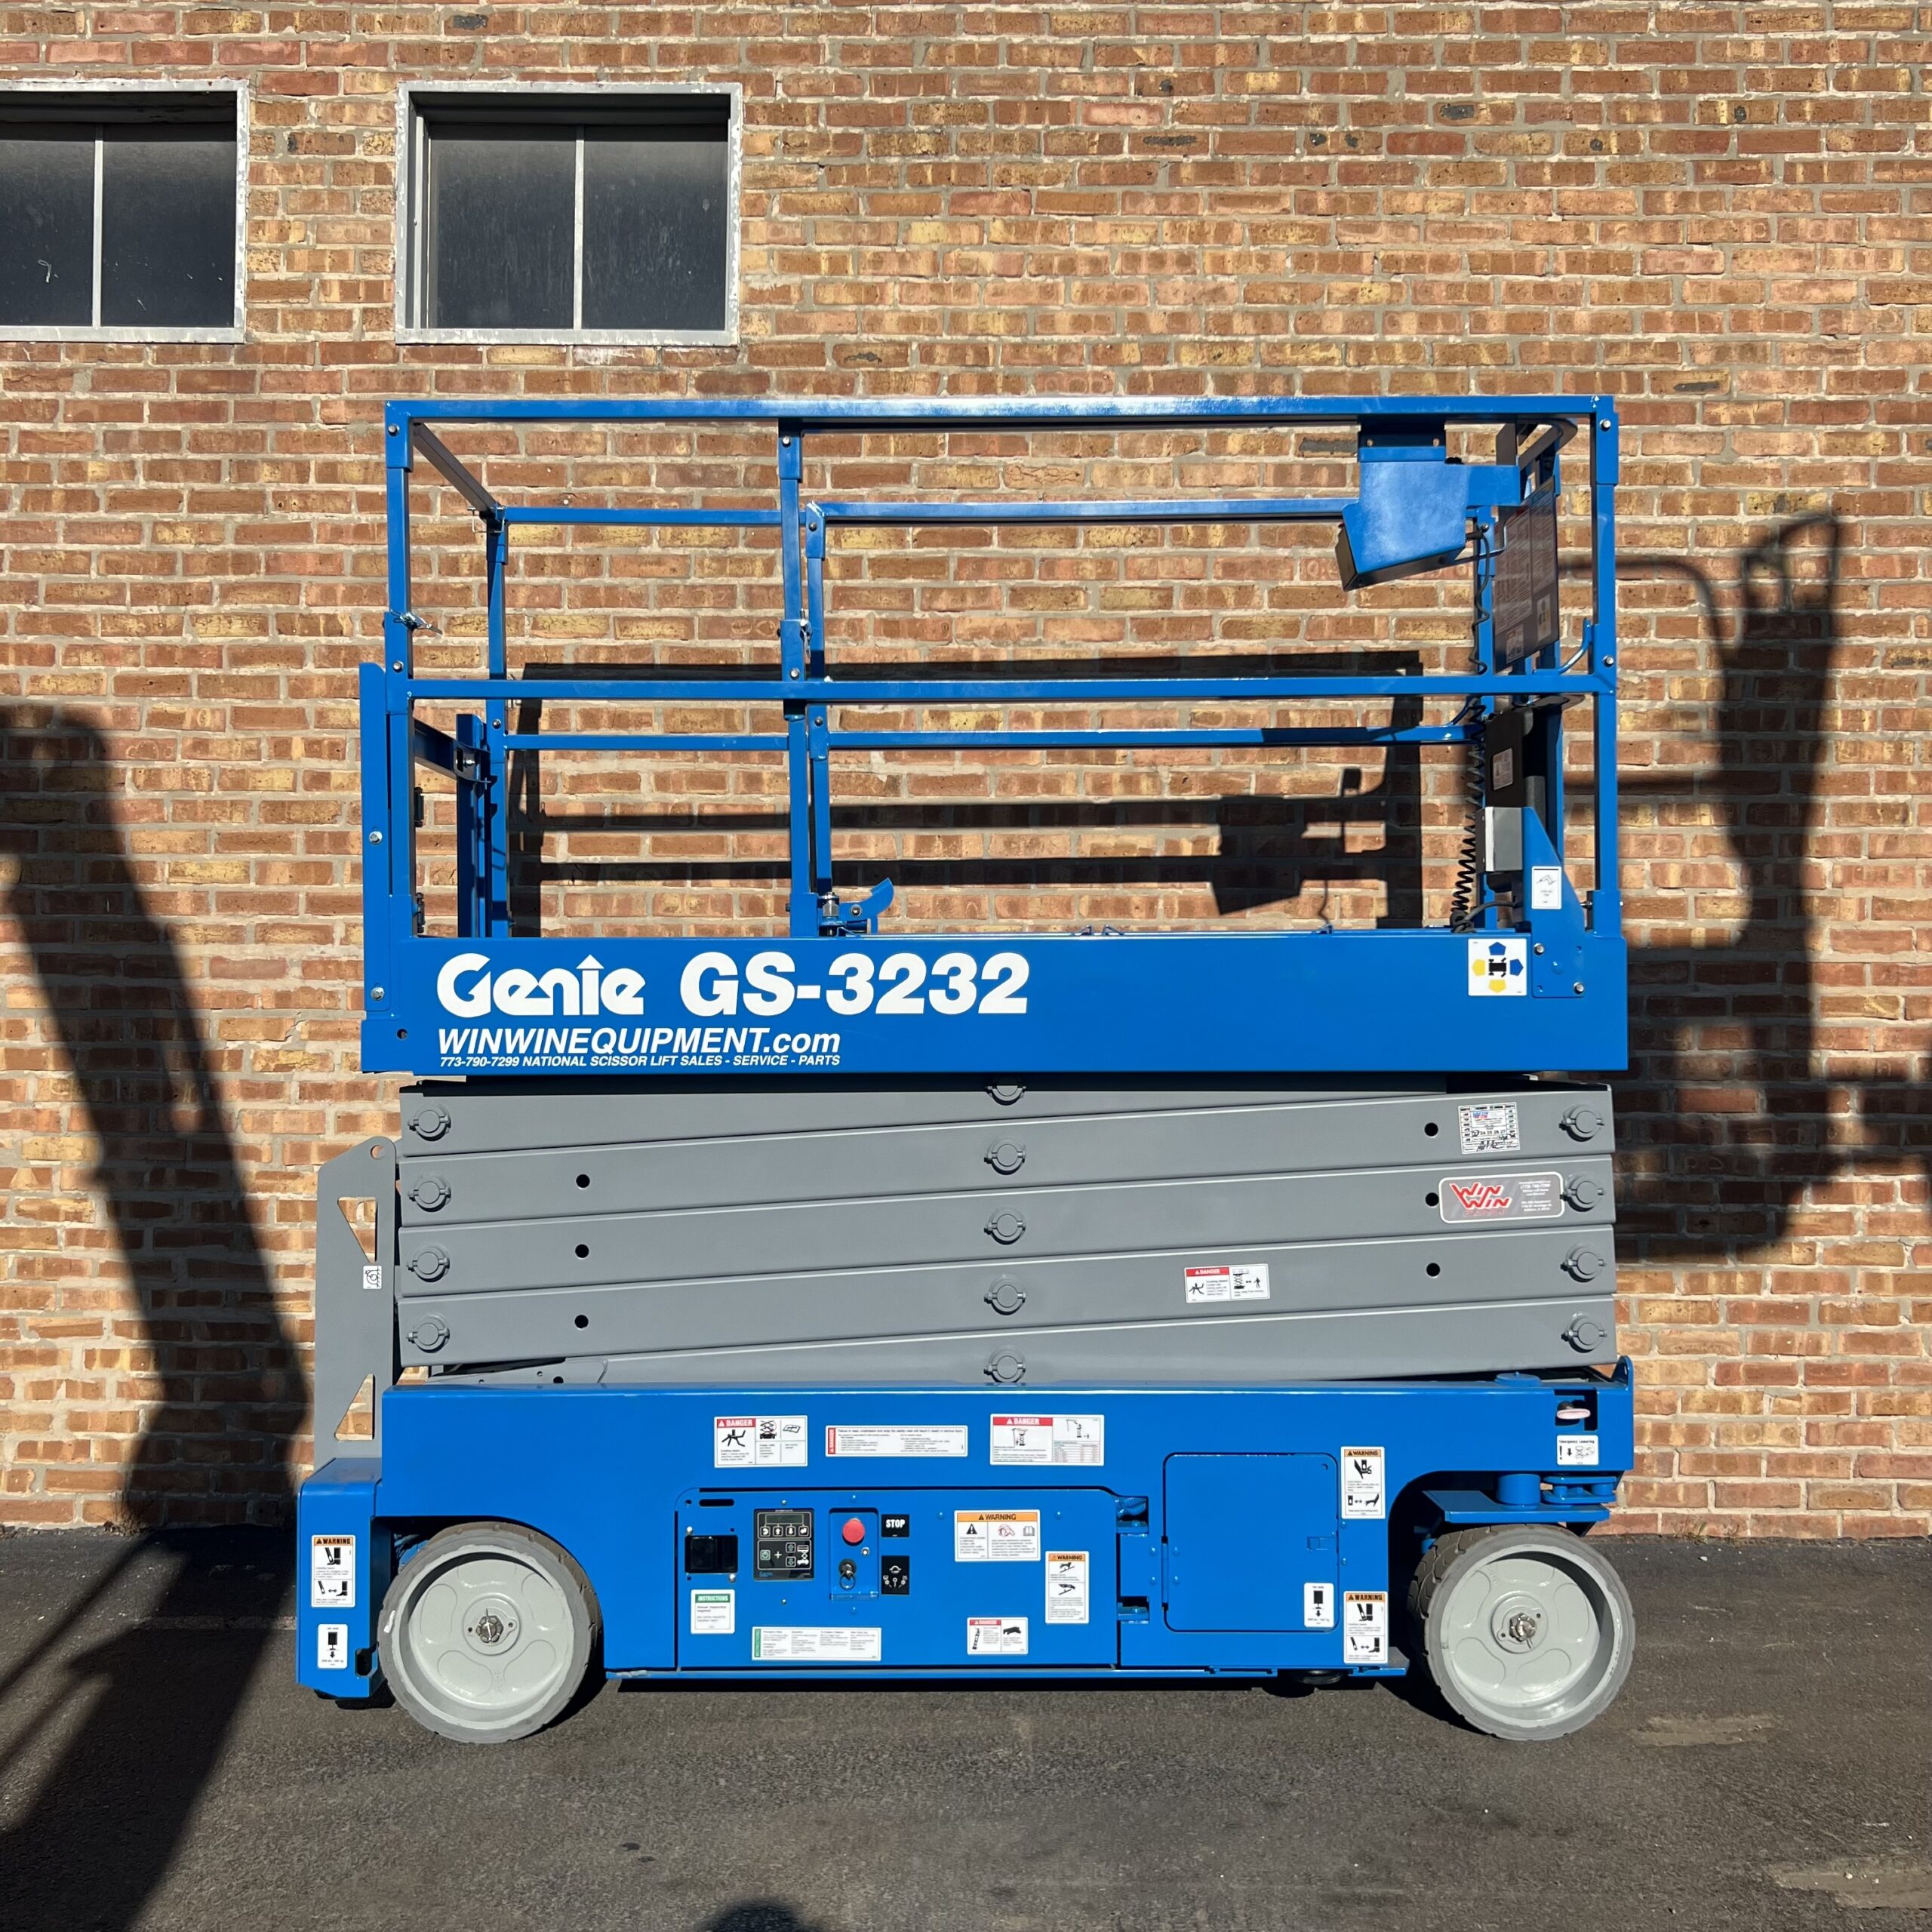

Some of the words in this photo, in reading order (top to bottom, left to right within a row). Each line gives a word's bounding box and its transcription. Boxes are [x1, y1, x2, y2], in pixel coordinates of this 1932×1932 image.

[437, 952, 646, 1018] Genie
[680, 951, 1029, 1017] GS-3232
[438, 1027, 841, 1055] WINWINEQUIPMENT.com
[440, 1056, 519, 1067] 773-790-7299
[522, 1056, 587, 1066] NATIONAL
[590, 1055, 648, 1066] SCISSOR
[650, 1055, 678, 1066] LIFT
[680, 1055, 722, 1066] SALES
[733, 1055, 789, 1066] SERVICE
[798, 1054, 841, 1066] PARTS
[885, 1519, 906, 1528] STOP
